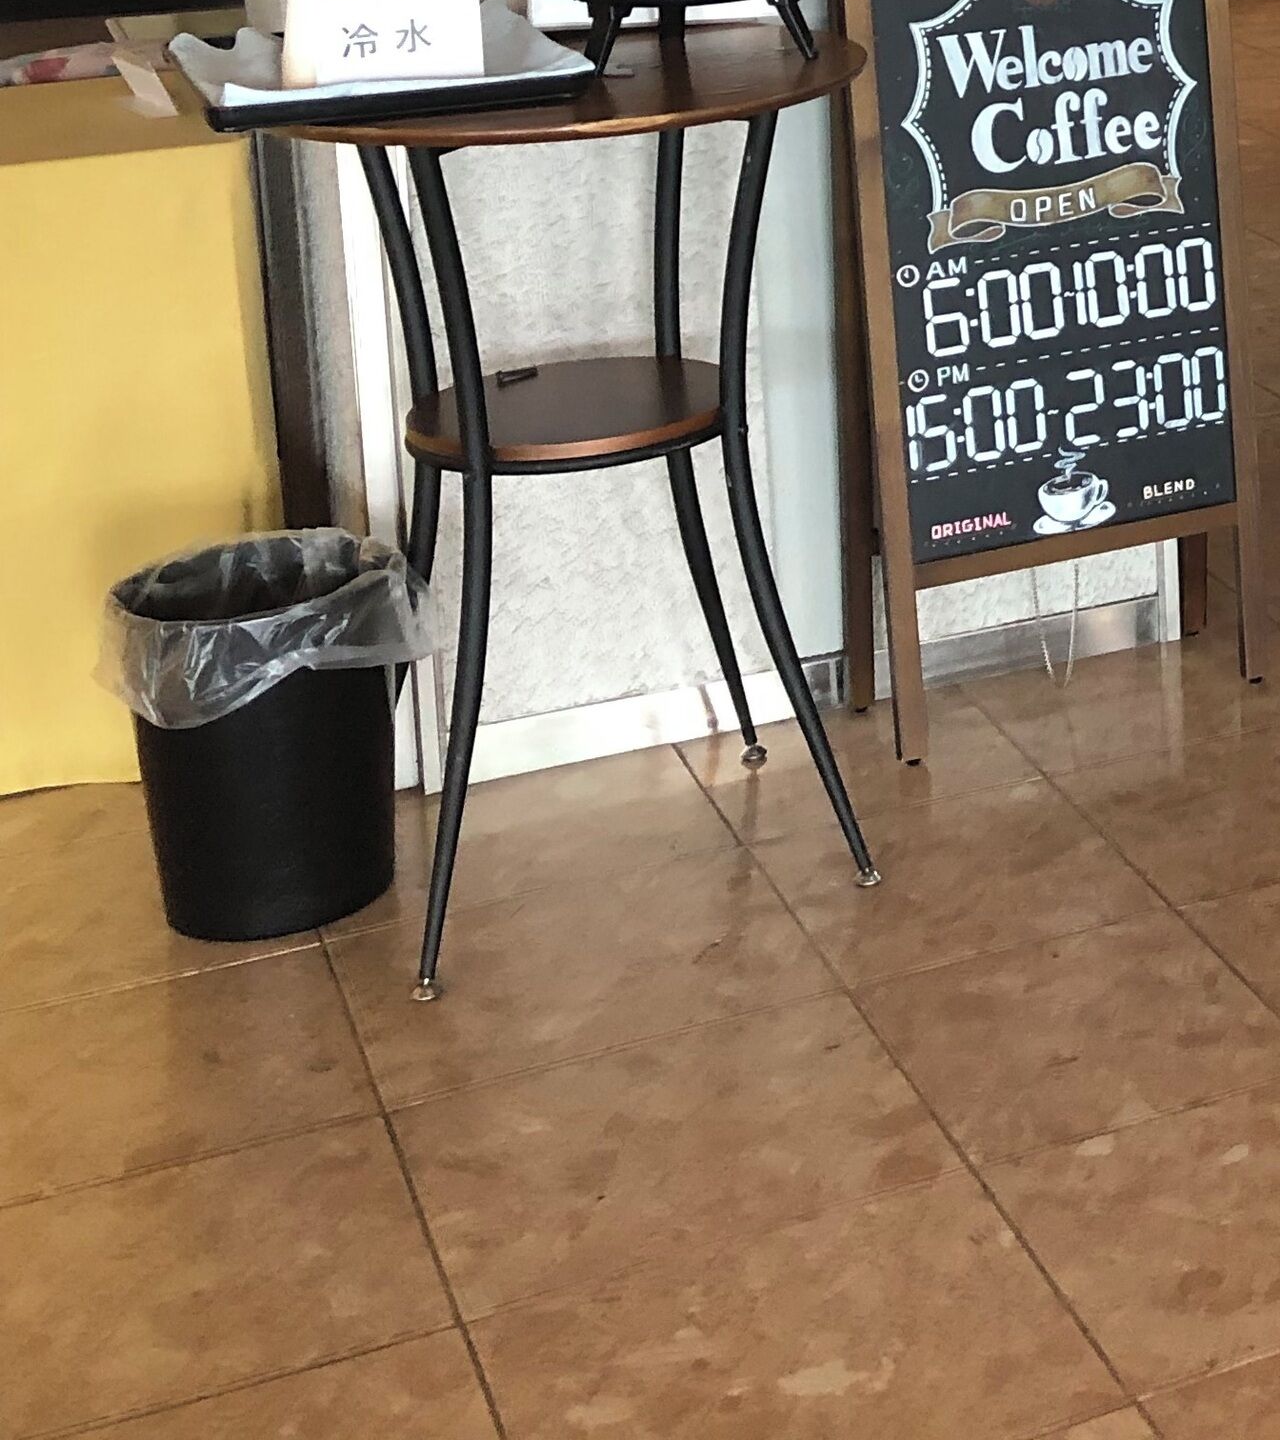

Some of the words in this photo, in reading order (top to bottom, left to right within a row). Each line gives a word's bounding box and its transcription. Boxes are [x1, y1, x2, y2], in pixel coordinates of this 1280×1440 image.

[341, 18, 433, 60] 冷水
[937, 24, 1154, 99] Welcome
[969, 86, 1162, 174] Coffee
[1009, 186, 1098, 222] OPEN
[925, 256, 968, 281] AM
[936, 363, 971, 387] PM
[1142, 477, 1196, 500] BLEND
[930, 510, 1012, 541] ORIGINAL
